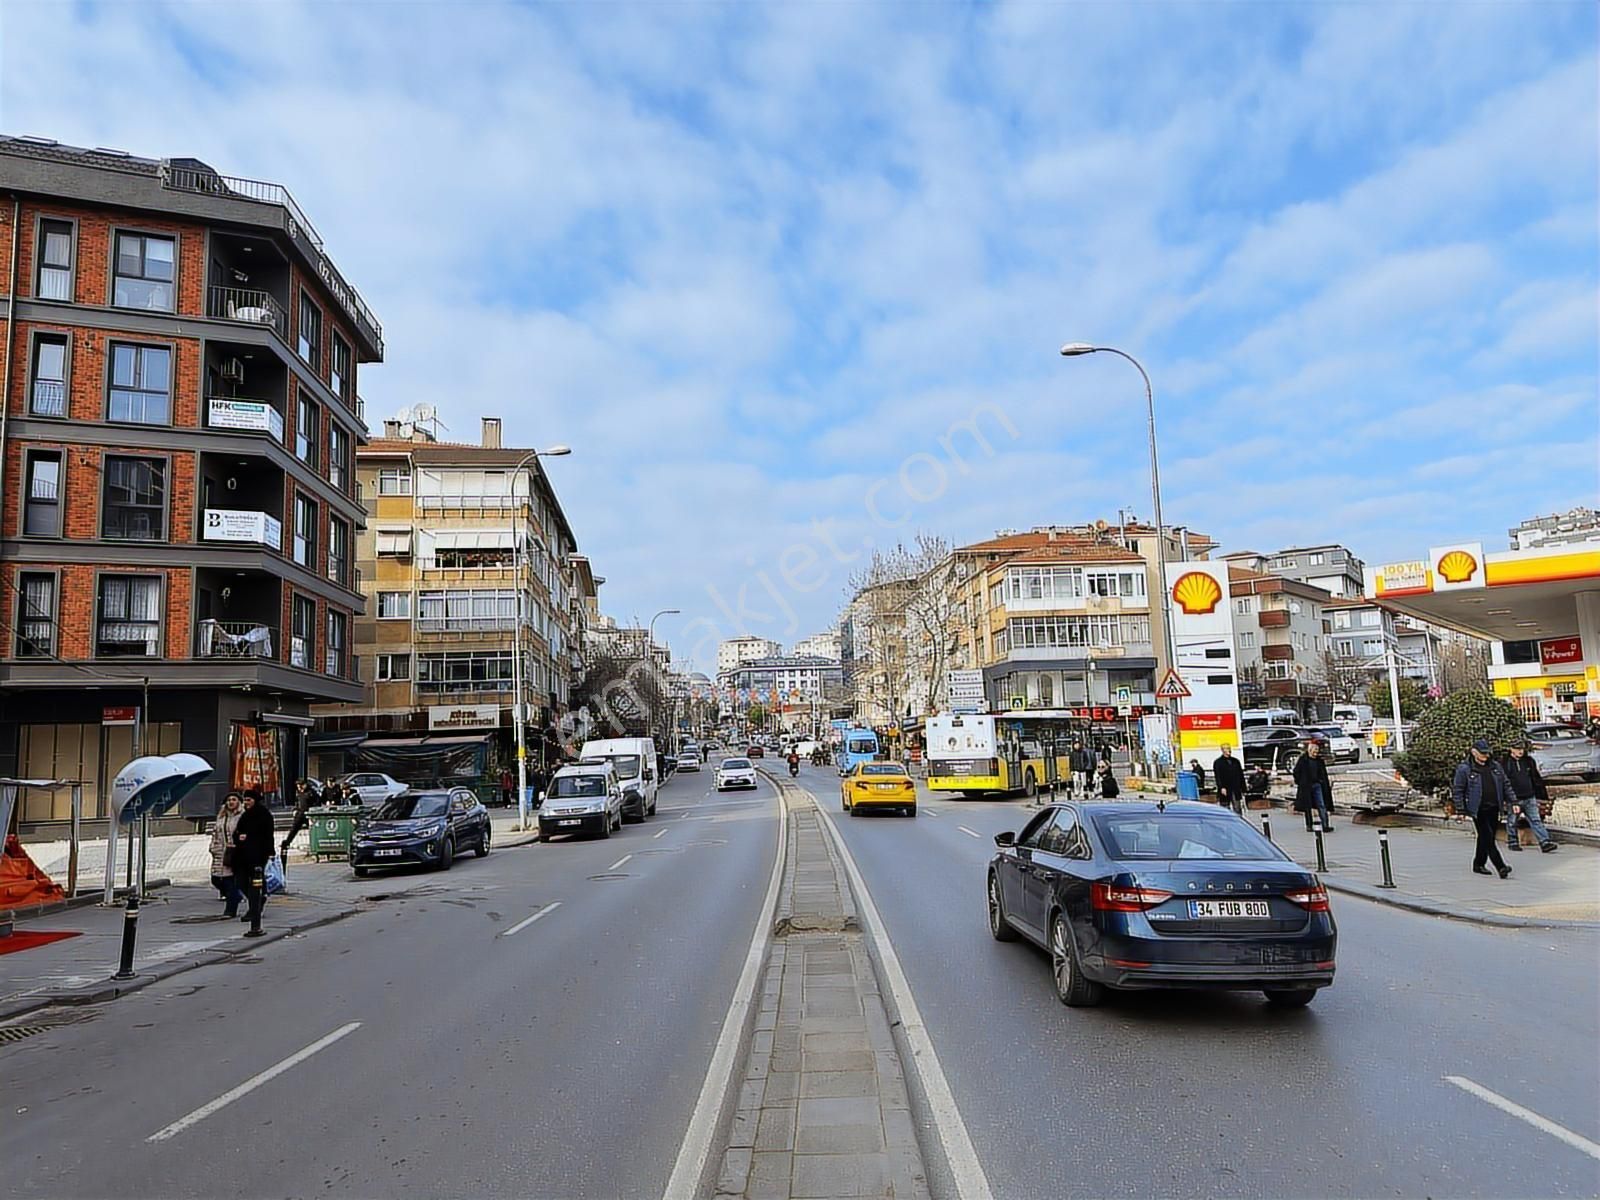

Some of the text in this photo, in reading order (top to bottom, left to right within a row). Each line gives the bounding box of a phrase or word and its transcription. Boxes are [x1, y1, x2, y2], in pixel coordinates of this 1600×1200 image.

[1197, 902, 1213, 916] 34
[1218, 902, 1242, 916] FUB
[1245, 902, 1268, 916] 800
